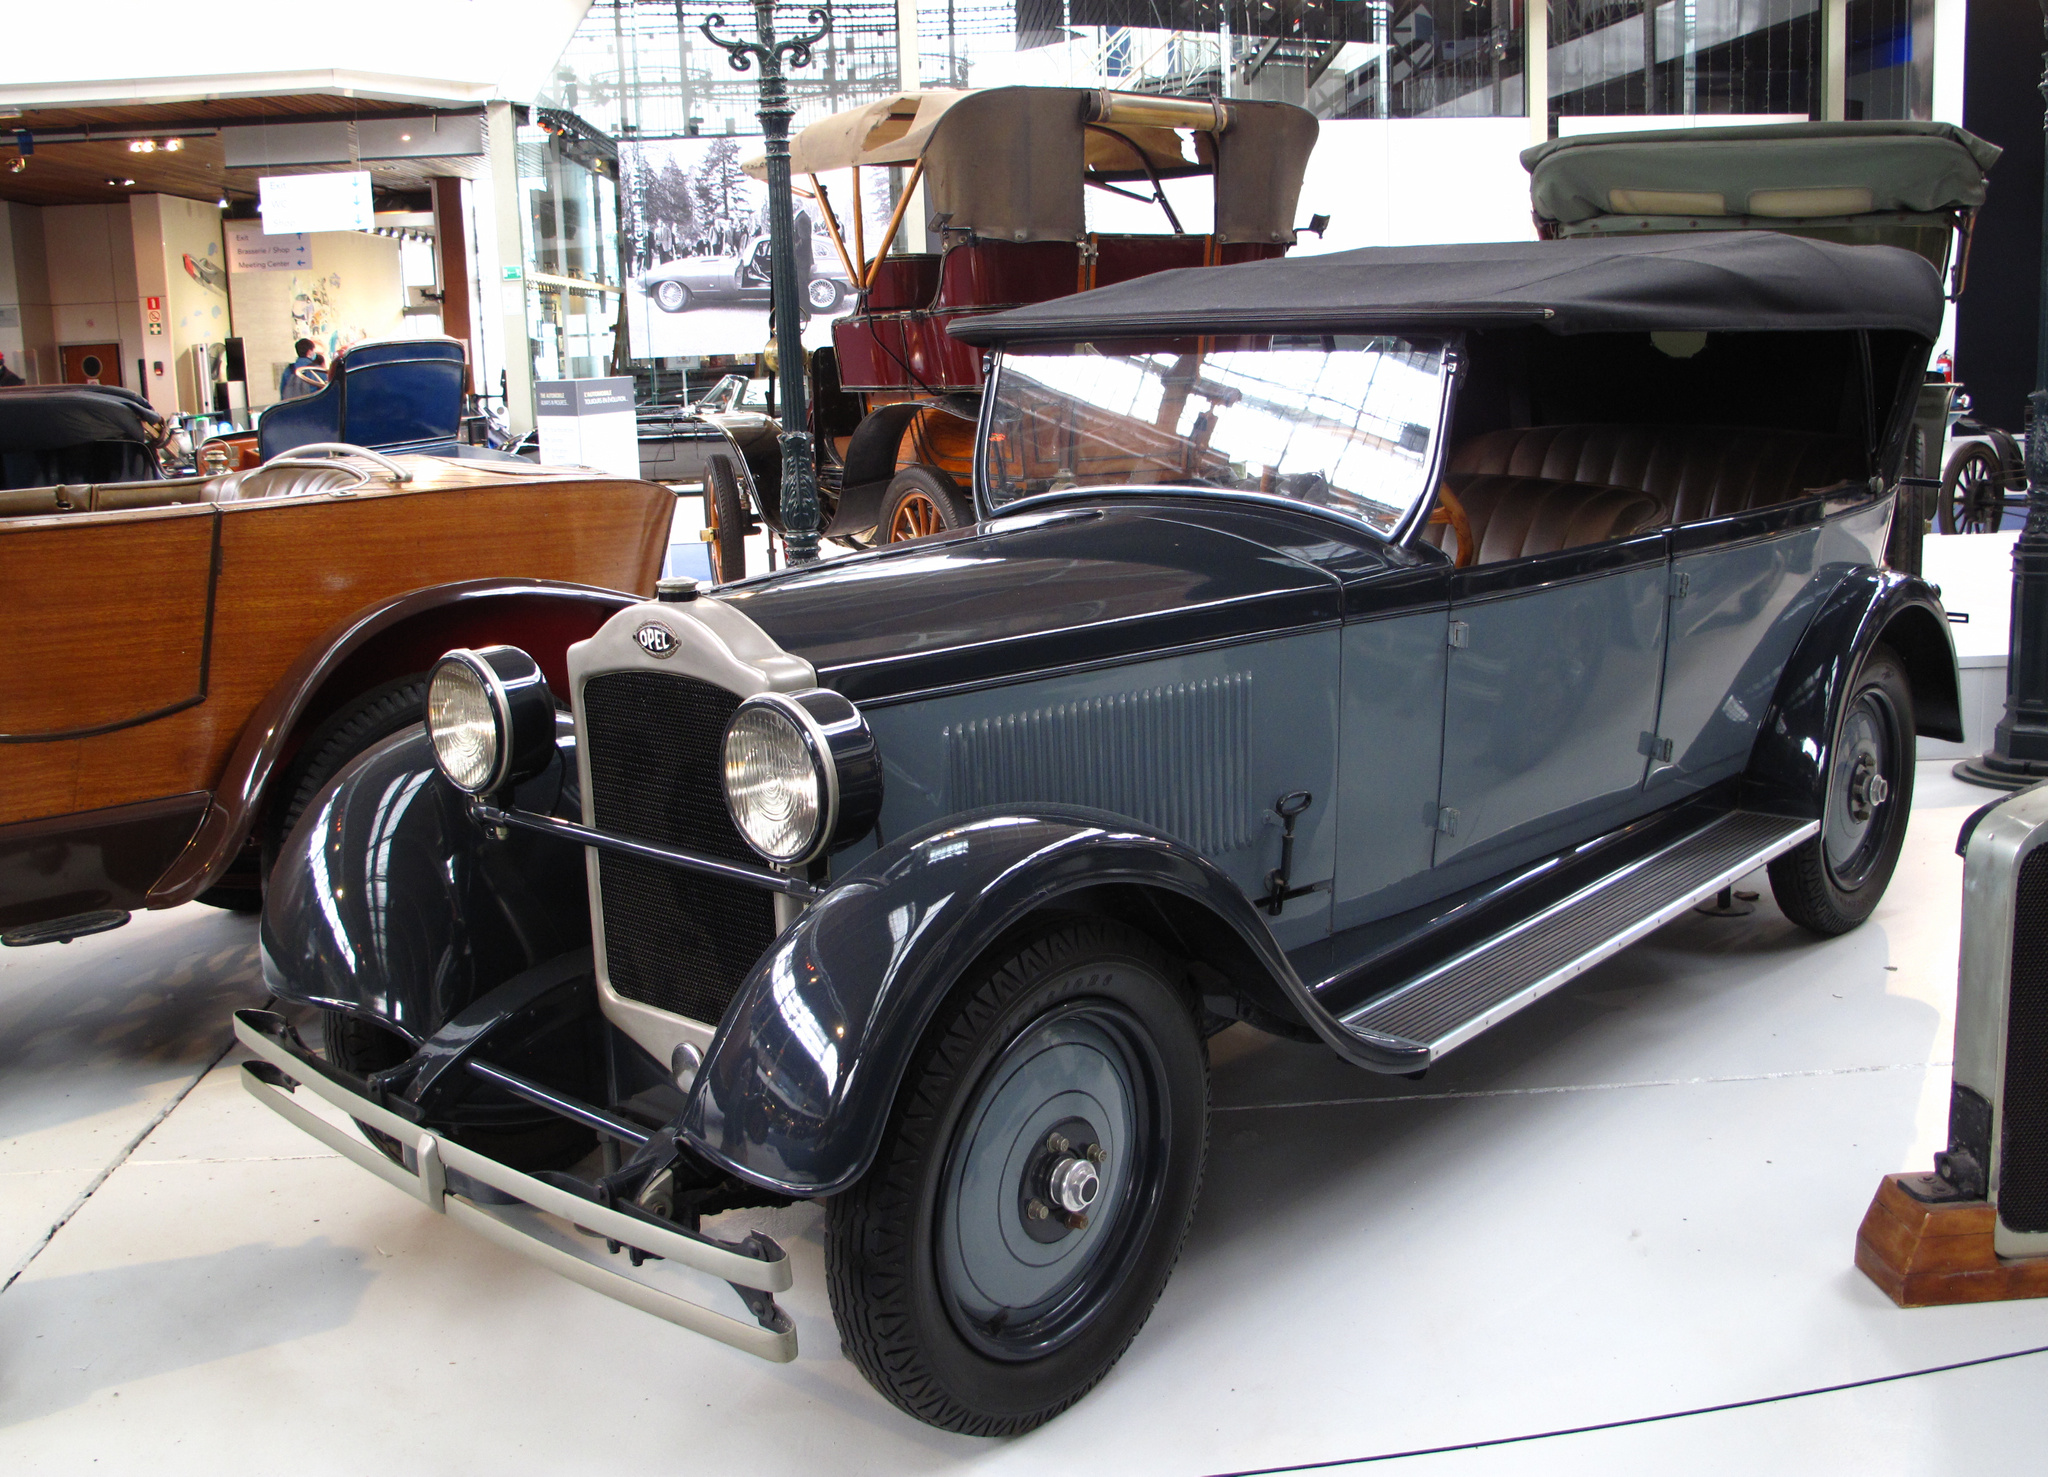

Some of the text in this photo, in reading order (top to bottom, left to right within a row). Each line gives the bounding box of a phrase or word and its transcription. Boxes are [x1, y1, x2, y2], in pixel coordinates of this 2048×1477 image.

[269, 181, 287, 191] Exit
[271, 199, 288, 209] WC
[633, 205, 647, 256] JAGUAR
[272, 246, 290, 254] Shop
[267, 260, 290, 268] Center
[639, 628, 670, 651] OPEL
